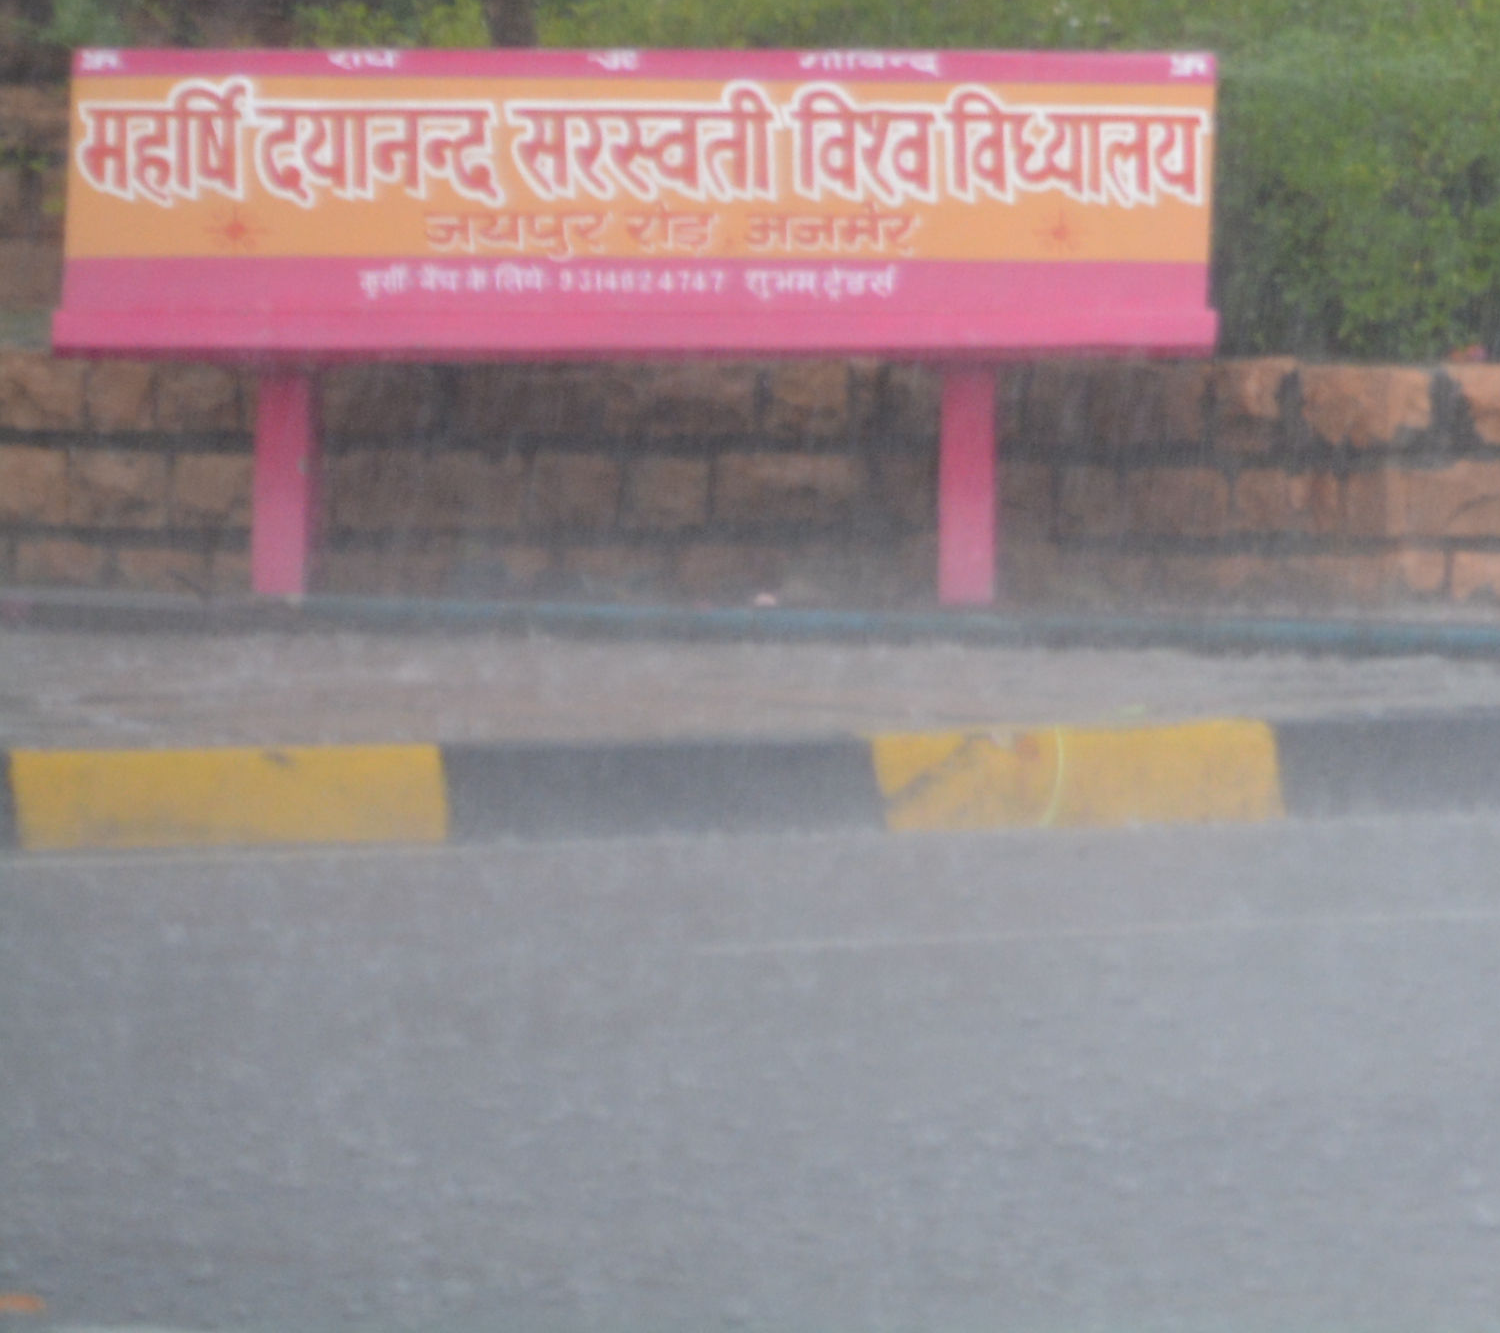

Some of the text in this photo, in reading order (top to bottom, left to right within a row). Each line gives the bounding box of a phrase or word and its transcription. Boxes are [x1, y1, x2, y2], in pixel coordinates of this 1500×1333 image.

[75, 78, 252, 209] महर्षि
[252, 100, 504, 209] दयानन्द
[504, 80, 782, 201] सरस्वती
[424, 210, 612, 262] जयपुर
[743, 200, 921, 258] अजमेर
